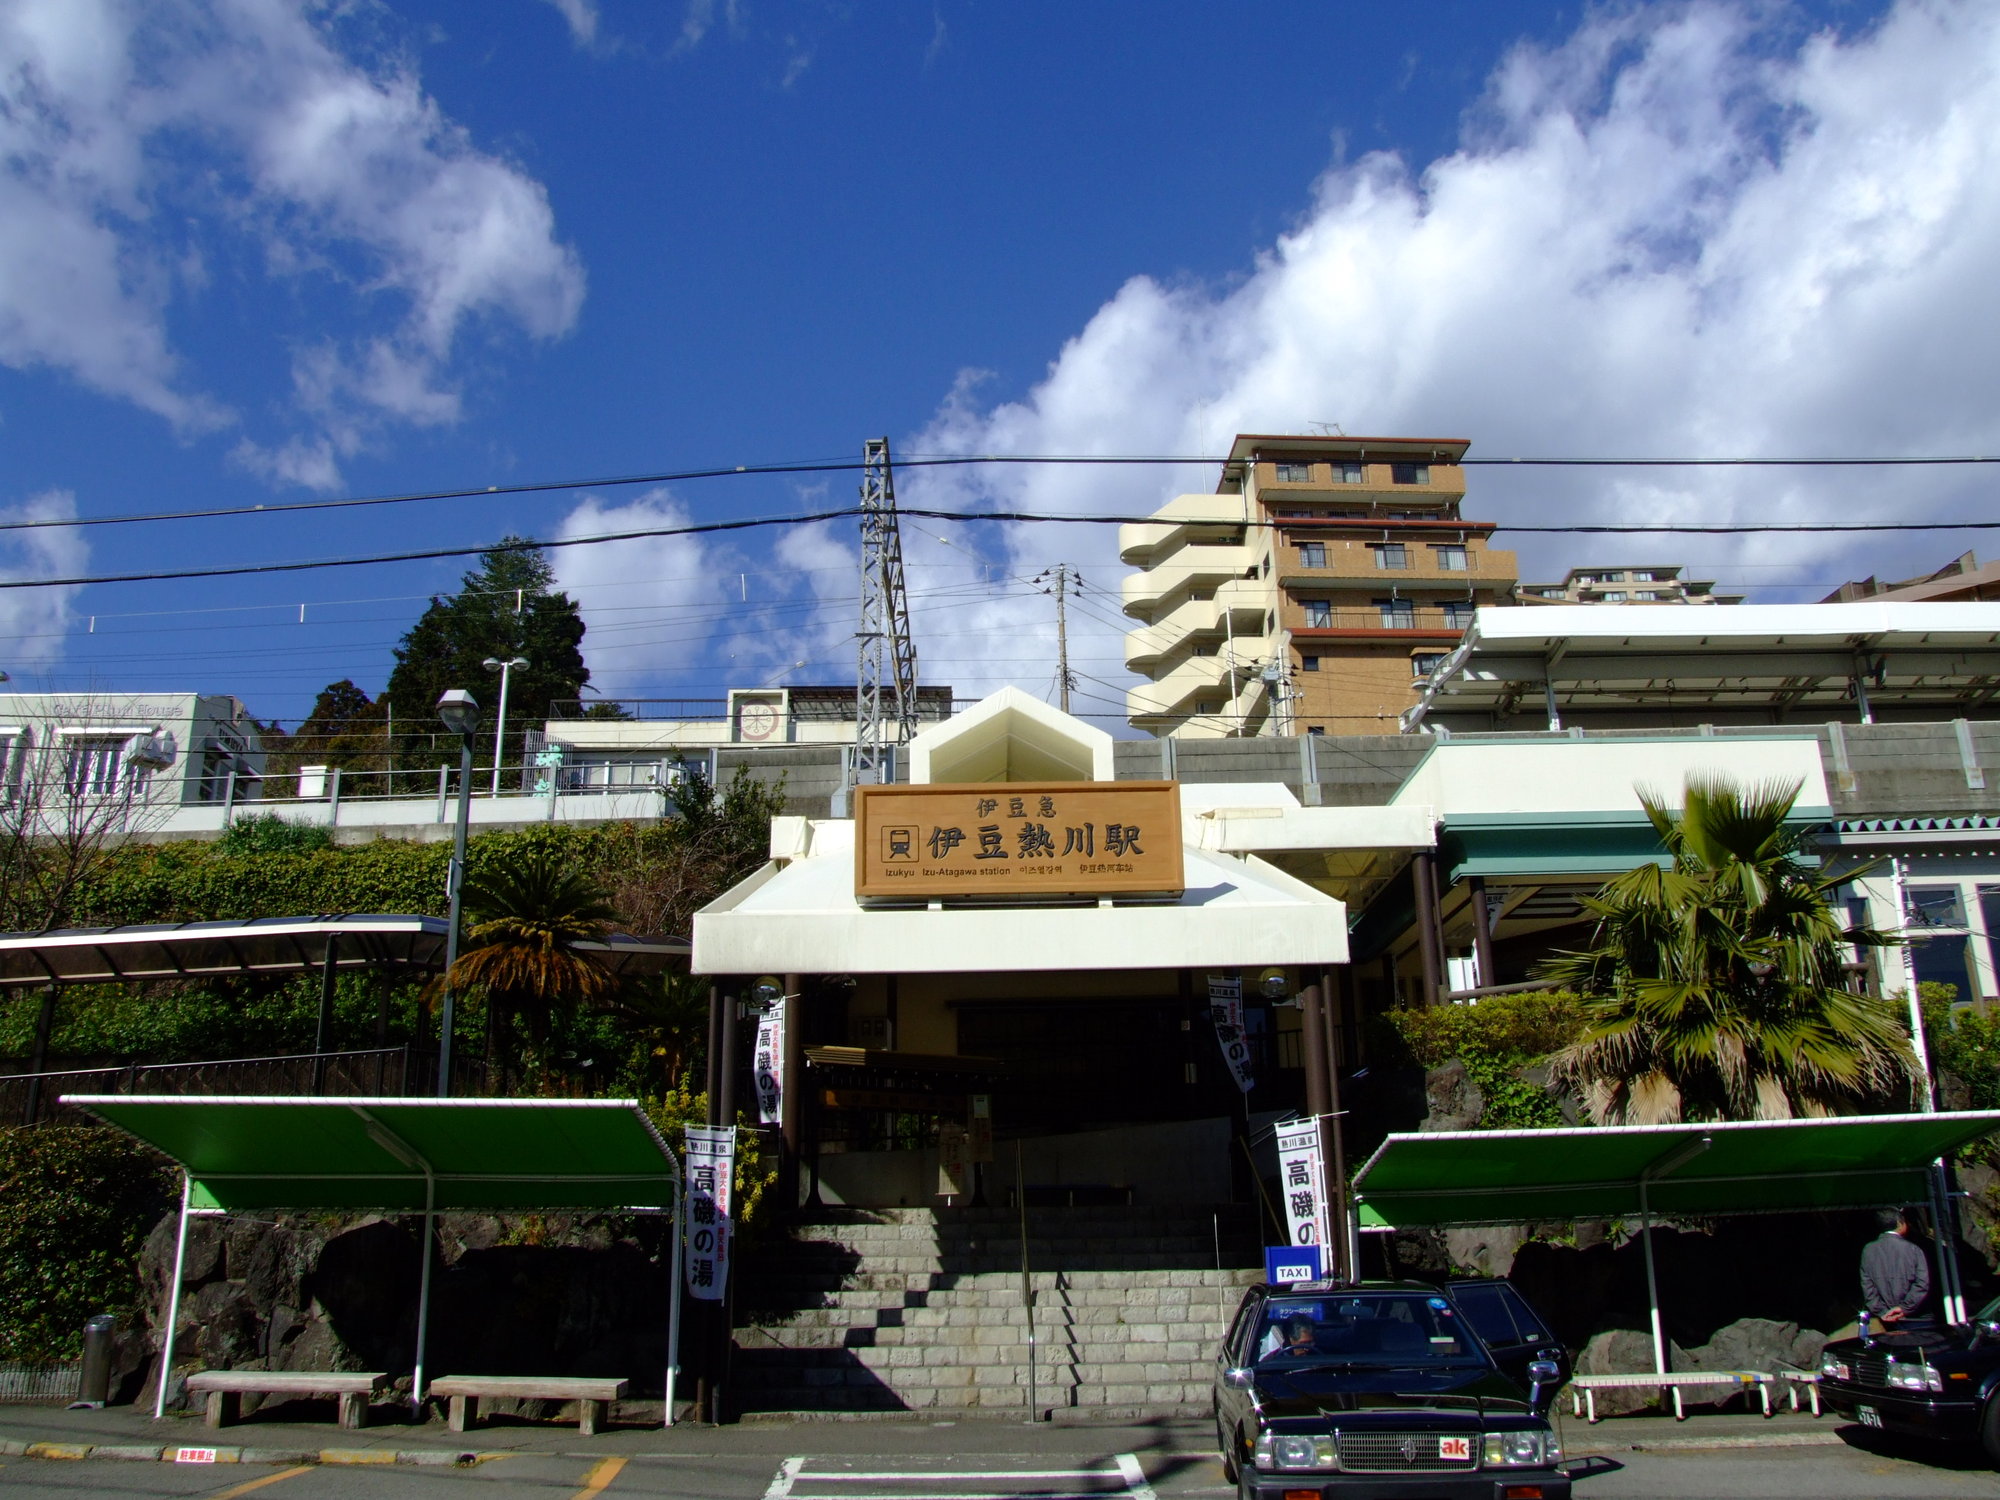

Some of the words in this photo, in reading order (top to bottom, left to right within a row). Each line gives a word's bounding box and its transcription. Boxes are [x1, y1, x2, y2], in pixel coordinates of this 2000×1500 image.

[136, 704, 184, 717] House
[976, 795, 1057, 819] 伊豆急
[927, 821, 1146, 860] 伊豆熱川駅
[885, 868, 915, 878] Izukyu
[922, 868, 978, 878] Izu-Atagawa
[979, 866, 1011, 876] station
[758, 1028, 777, 1114] 高磯の湯
[691, 1164, 716, 1289] 高磯の湯
[1279, 1267, 1308, 1278] TAXI
[1441, 1438, 1467, 1455] ak
